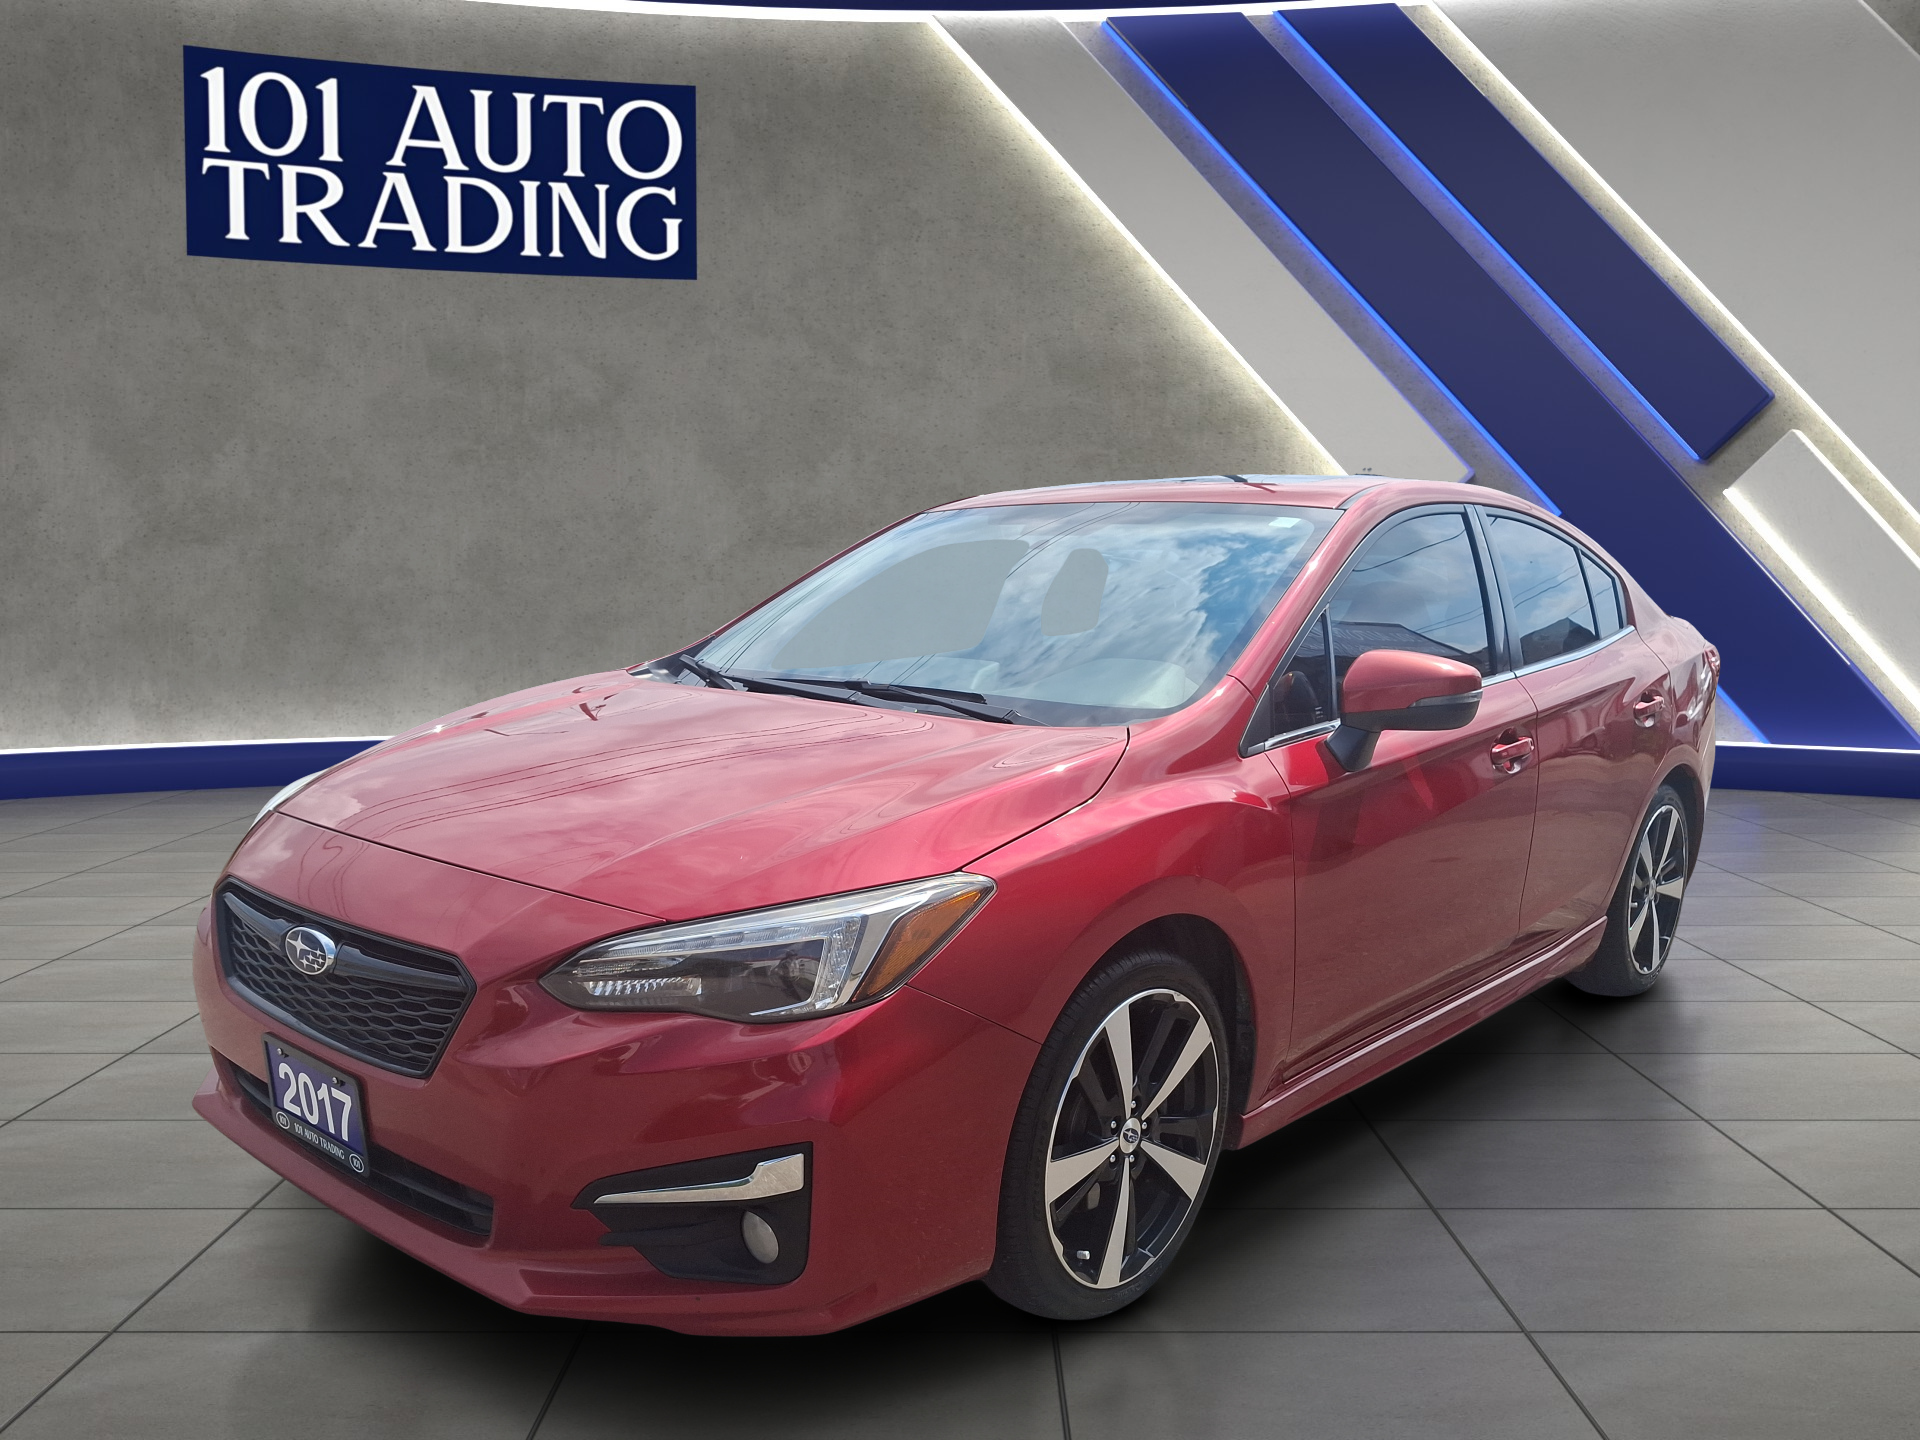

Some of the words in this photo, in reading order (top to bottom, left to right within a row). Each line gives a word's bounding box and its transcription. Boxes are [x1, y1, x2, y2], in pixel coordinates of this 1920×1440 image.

[201, 66, 343, 161] 101
[386, 85, 683, 180] AUTO
[202, 157, 683, 261] TRADING
[278, 1062, 352, 1142] 2017
[294, 1122, 303, 1136] 101
[304, 1128, 319, 1144] AUTO
[319, 1136, 345, 1160] TRADING
